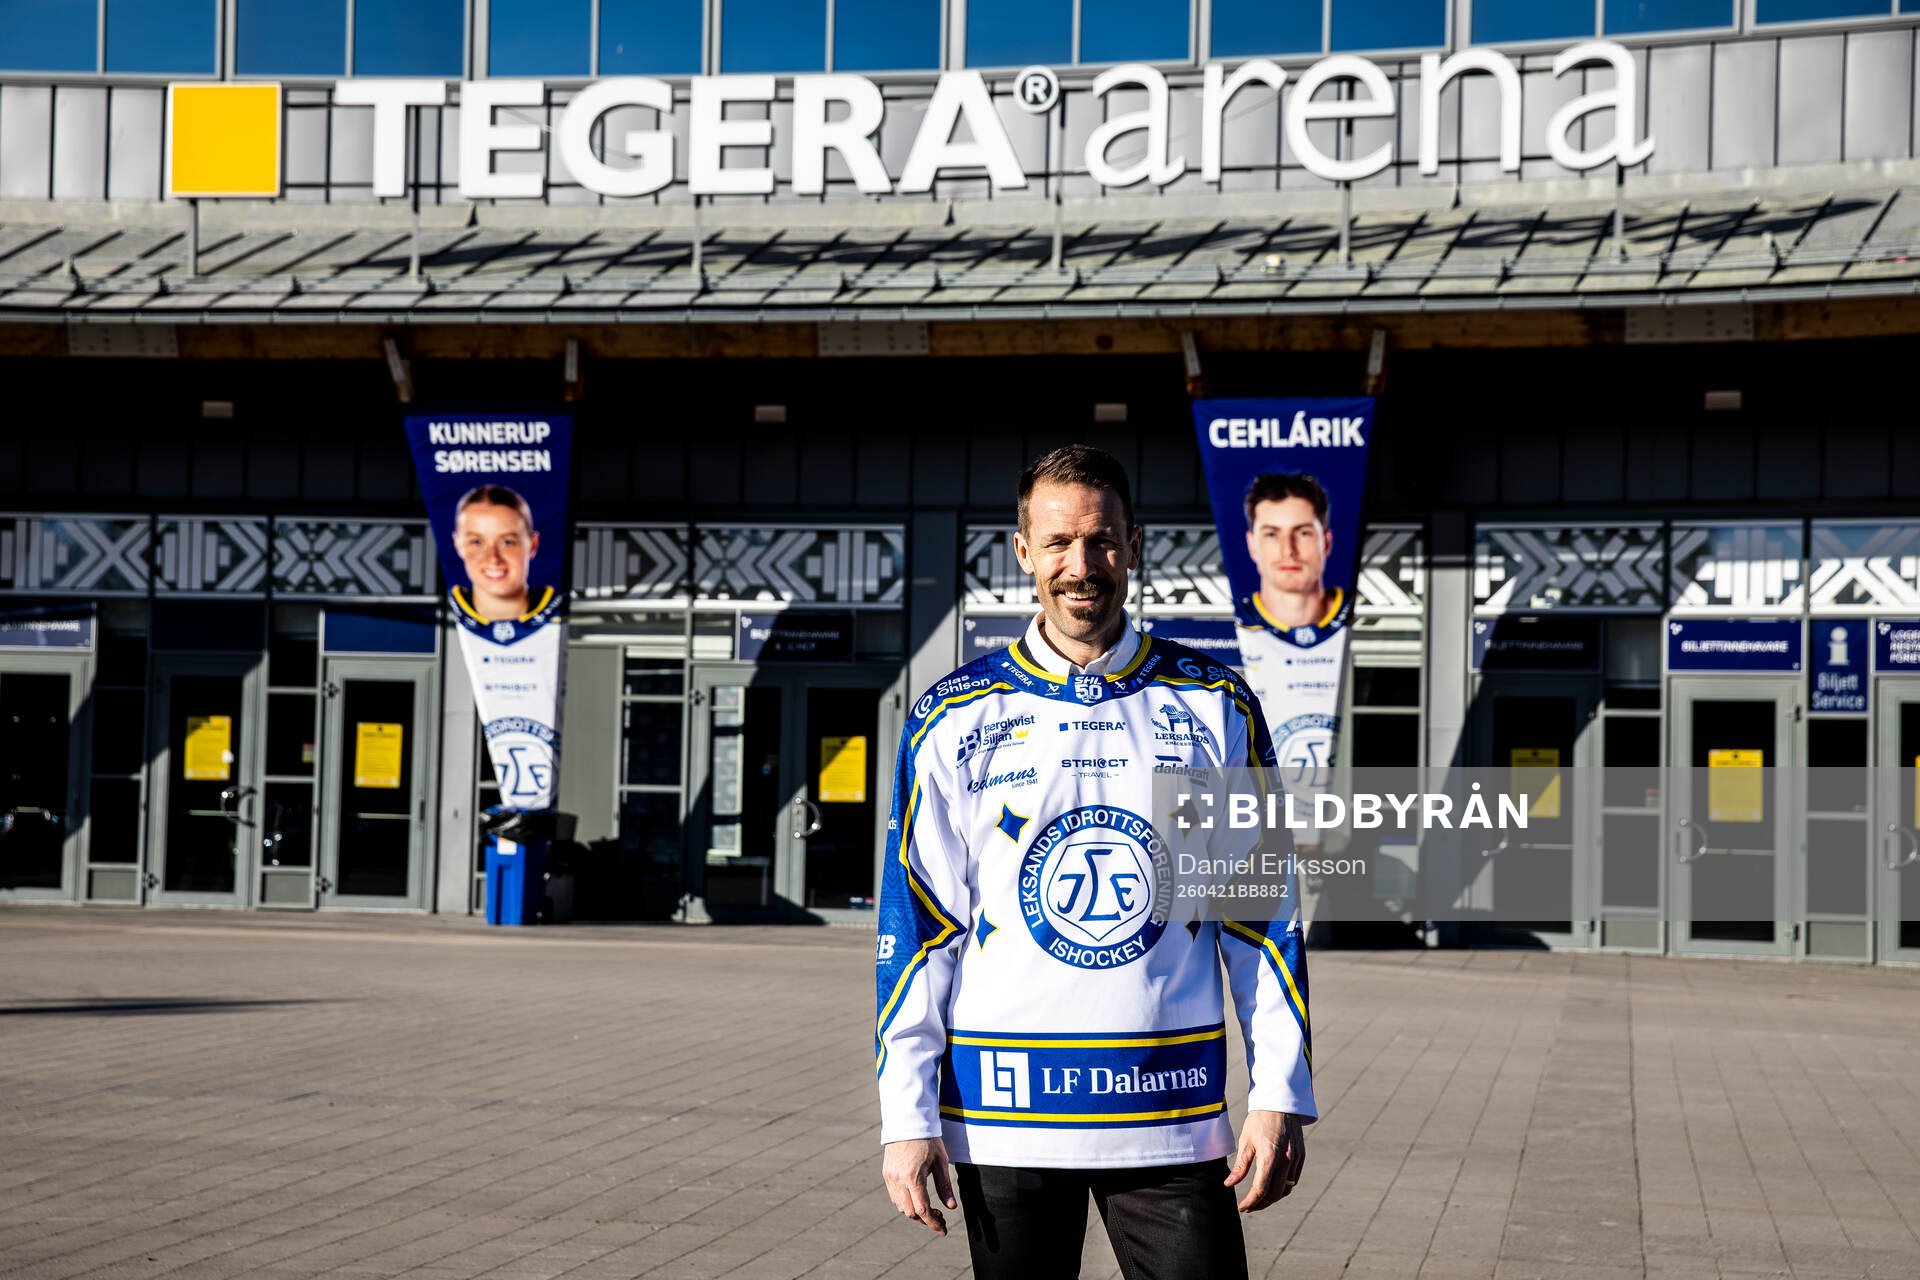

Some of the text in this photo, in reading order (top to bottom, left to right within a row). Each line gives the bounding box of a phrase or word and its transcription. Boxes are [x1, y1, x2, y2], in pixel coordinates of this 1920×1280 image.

[1084, 40, 1656, 188] arena
[428, 421, 551, 445] KUNNERUP
[1208, 411, 1366, 448] CEHLÁRIK
[434, 449, 552, 473] SØRENSEN
[936, 674, 970, 691] Clas
[938, 678, 991, 697] Ohlson
[1074, 683, 1103, 701] 50
[1817, 672, 1859, 693] Biljett
[1812, 691, 1865, 709] Service
[983, 714, 1036, 735] Bergkvist
[982, 731, 1012, 747] Siljan
[1154, 732, 1210, 745] LEKSANDS
[1078, 771, 1112, 779] TRAVEL
[1153, 762, 1210, 781] dalakraft
[1011, 781, 1025, 790] since
[1022, 808, 1171, 929] LEKSANDS IDROTTSFÖRENING
[876, 934, 897, 960] B
[1048, 934, 1148, 967] ISHOCKEY
[1041, 1066, 1208, 1095] LF Dalarnas
